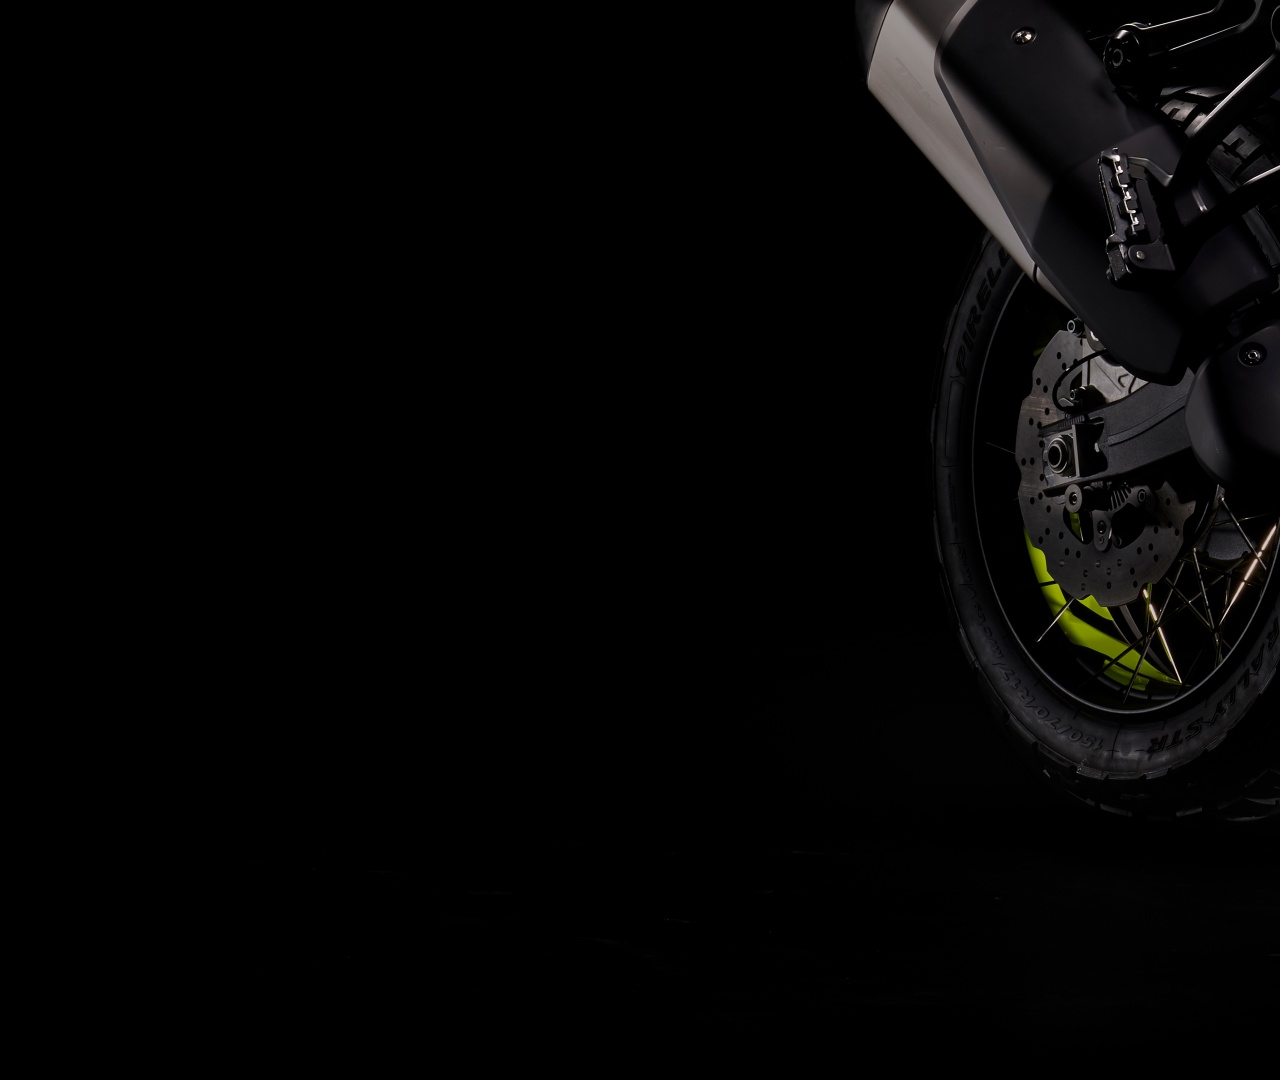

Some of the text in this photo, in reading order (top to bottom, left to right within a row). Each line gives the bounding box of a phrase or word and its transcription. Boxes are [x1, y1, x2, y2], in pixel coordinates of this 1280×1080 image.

[955, 247, 1011, 377] PIRELL
[1209, 615, 1279, 726] RALLY
[1146, 715, 1204, 760] STR
